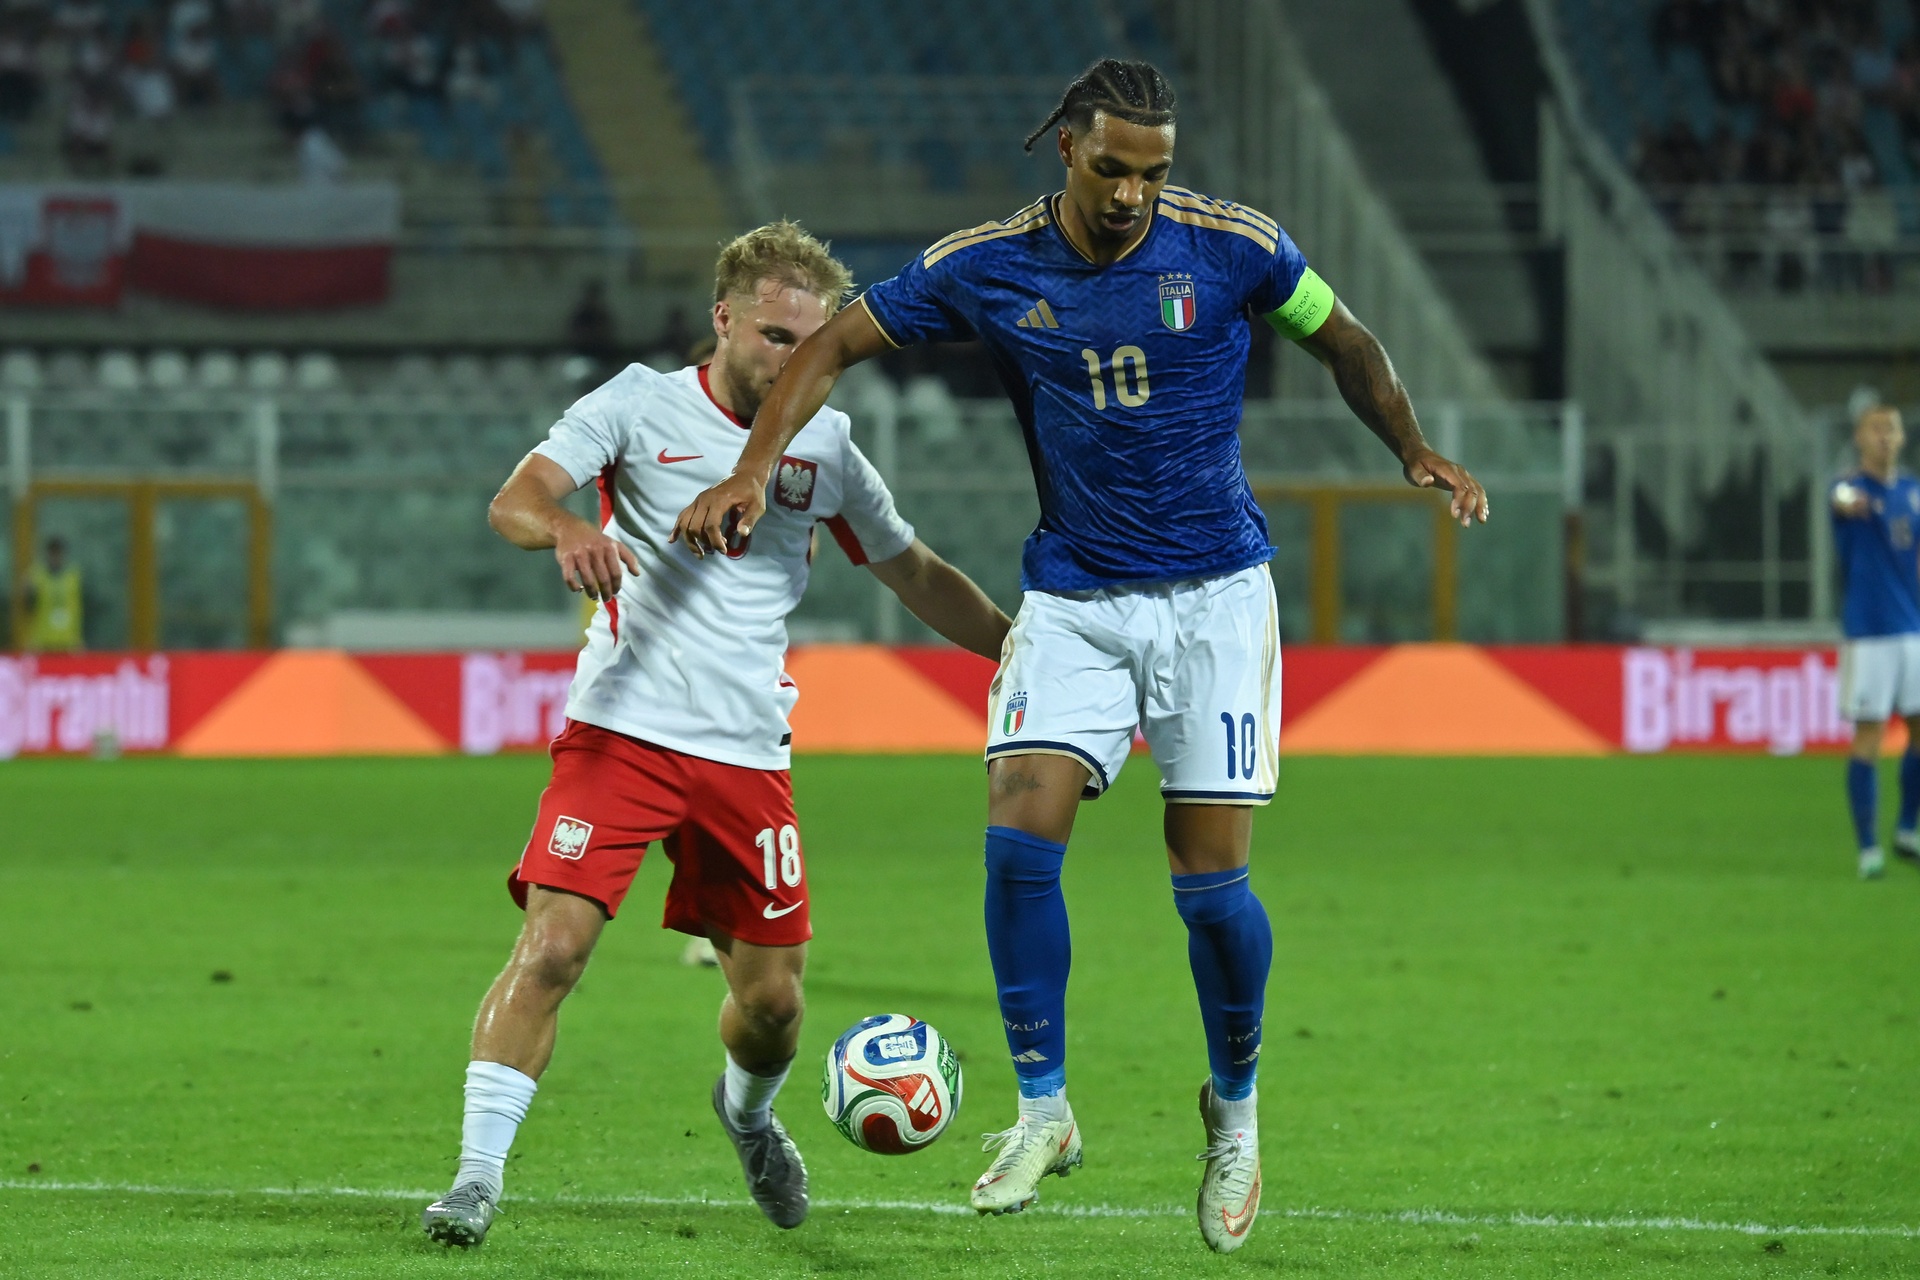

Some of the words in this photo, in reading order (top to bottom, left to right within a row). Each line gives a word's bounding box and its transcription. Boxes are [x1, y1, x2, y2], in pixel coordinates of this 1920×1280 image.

[1161, 285, 1192, 296] ITALIA
[1290, 302, 1319, 330] SPECT
[1081, 345, 1151, 411] 10
[1621, 647, 1854, 755] Biragh
[1220, 711, 1256, 780] 10
[755, 823, 802, 890] 18
